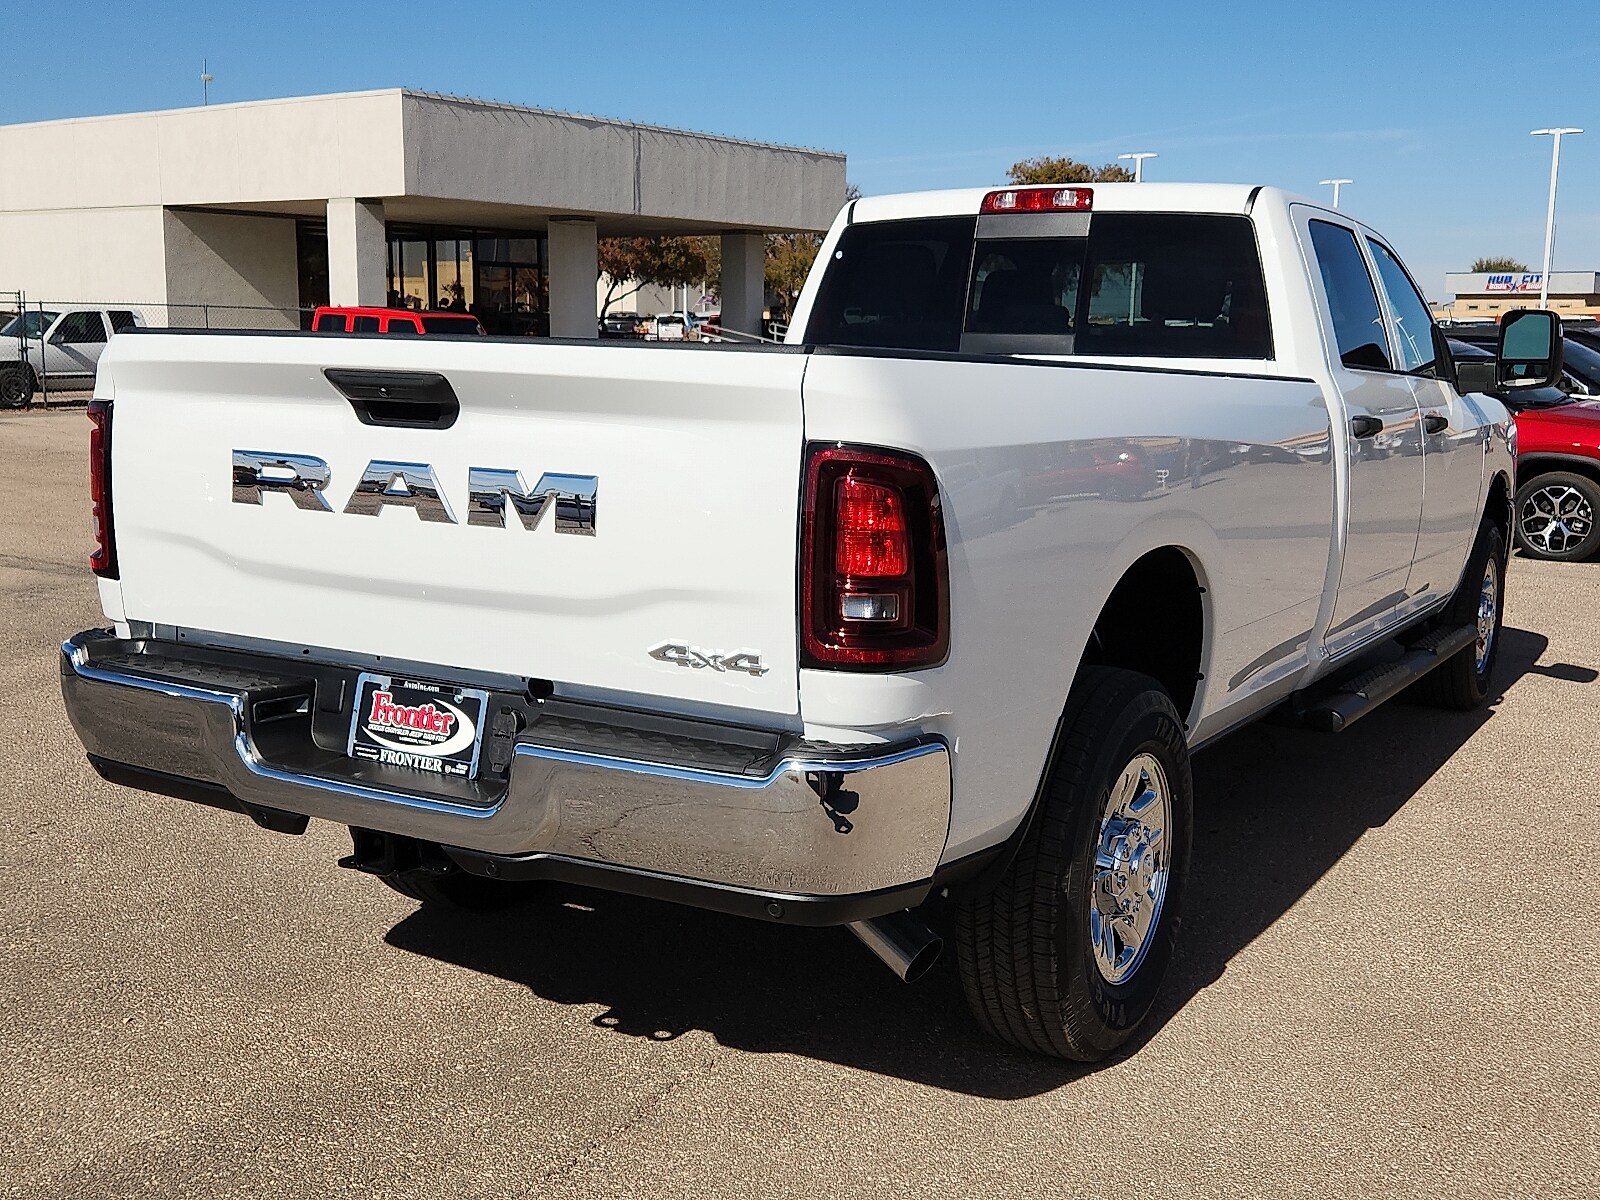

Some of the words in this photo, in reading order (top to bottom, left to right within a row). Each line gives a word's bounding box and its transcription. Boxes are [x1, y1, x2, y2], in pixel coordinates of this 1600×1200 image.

[1487, 275, 1513, 284] HUB
[232, 449, 599, 537] RAM
[369, 690, 455, 735] Frontier
[379, 748, 442, 773] FRONTIER
